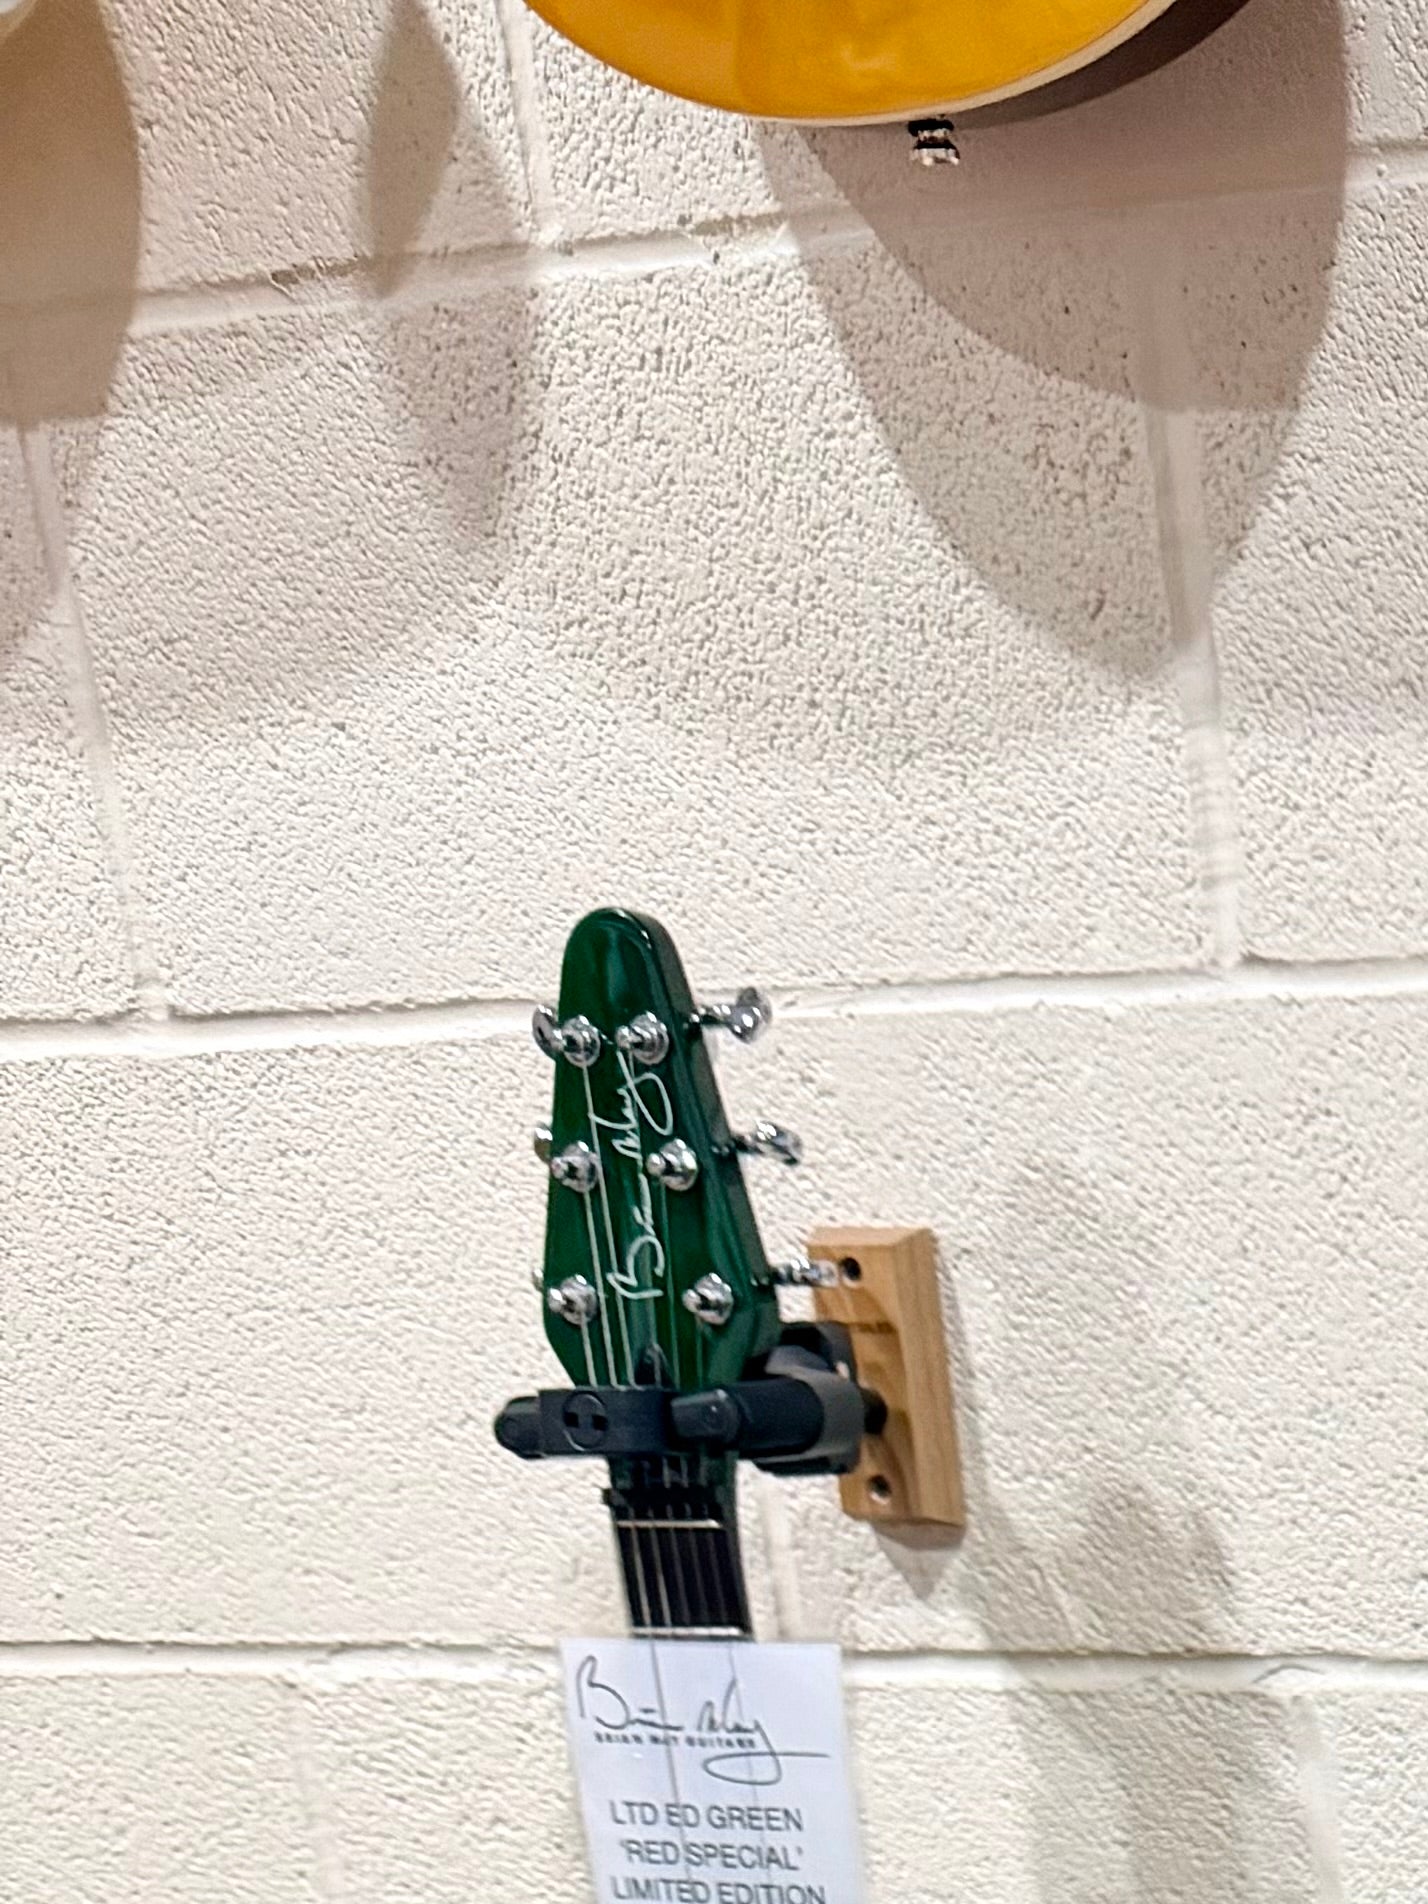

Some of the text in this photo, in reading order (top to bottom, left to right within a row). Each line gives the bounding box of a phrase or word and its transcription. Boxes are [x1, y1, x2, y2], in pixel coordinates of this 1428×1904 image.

[610, 1800, 804, 1832] LTD ED GREEN
[610, 1875, 710, 1904] LIMITED
